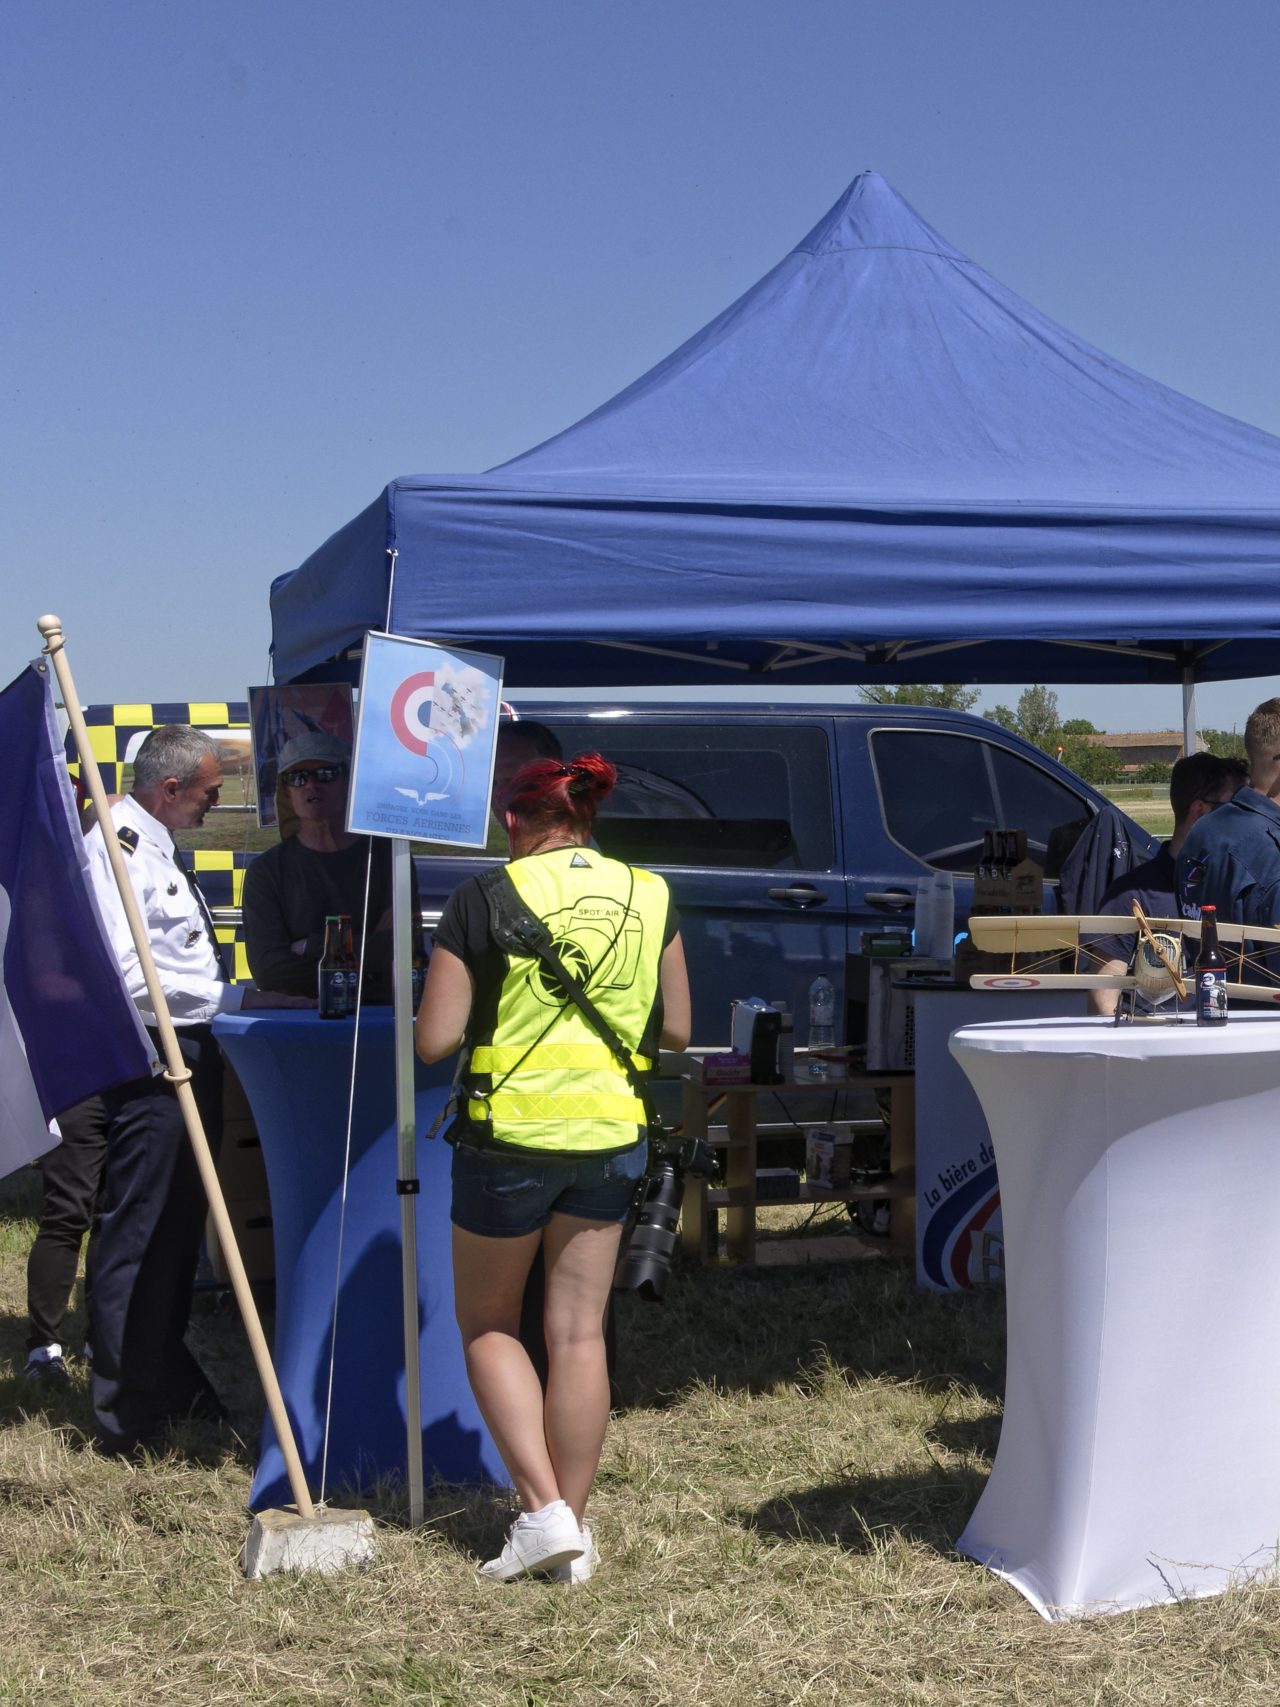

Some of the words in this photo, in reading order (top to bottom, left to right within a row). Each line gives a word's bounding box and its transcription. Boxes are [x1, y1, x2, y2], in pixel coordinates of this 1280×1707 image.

[366, 811, 409, 826] FORCES
[412, 818, 472, 834] AERIENNES
[923, 1186, 941, 1209] La
[938, 1159, 977, 1192] bière
